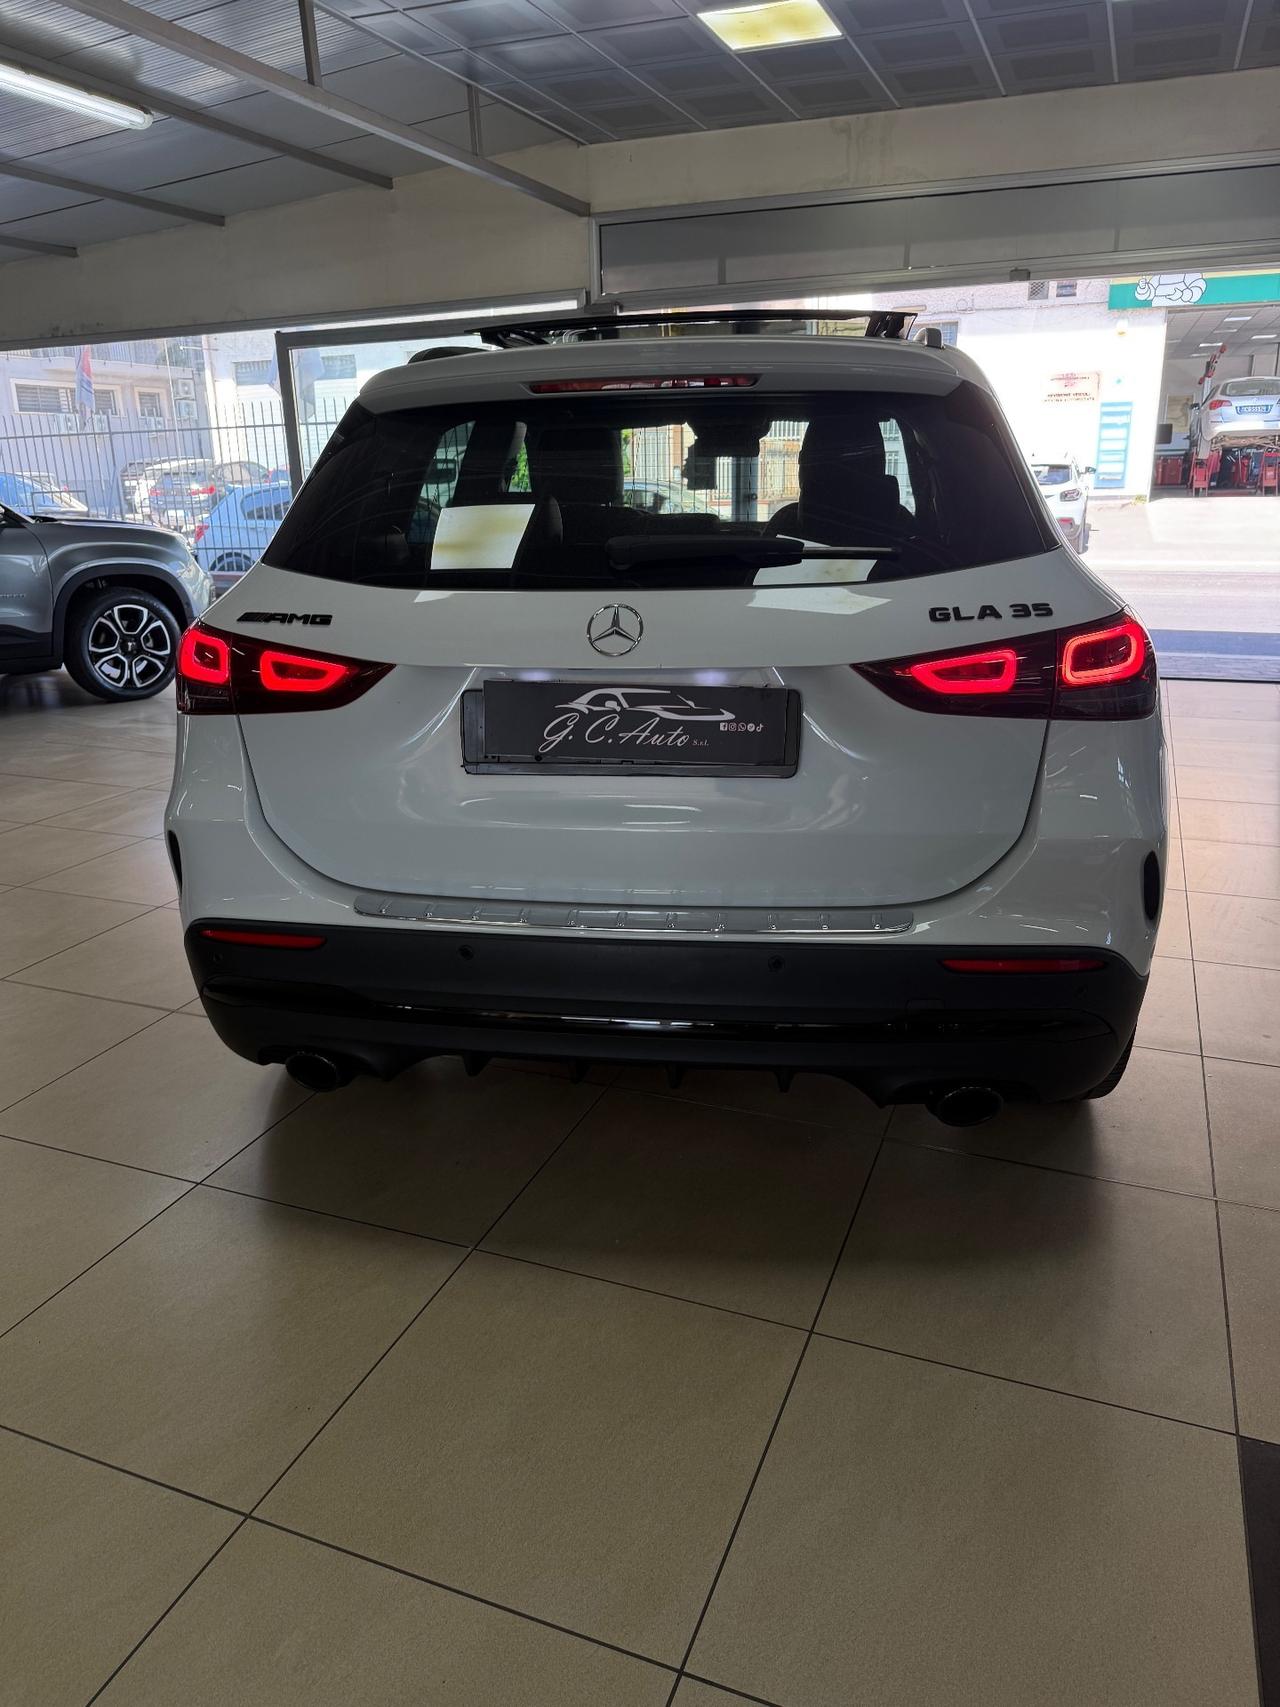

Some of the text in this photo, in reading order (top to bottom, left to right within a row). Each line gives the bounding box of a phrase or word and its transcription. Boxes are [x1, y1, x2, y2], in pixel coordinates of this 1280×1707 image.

[258, 611, 333, 626] AMG
[928, 602, 1054, 623] GLA 35
[619, 717, 690, 747] Auto
